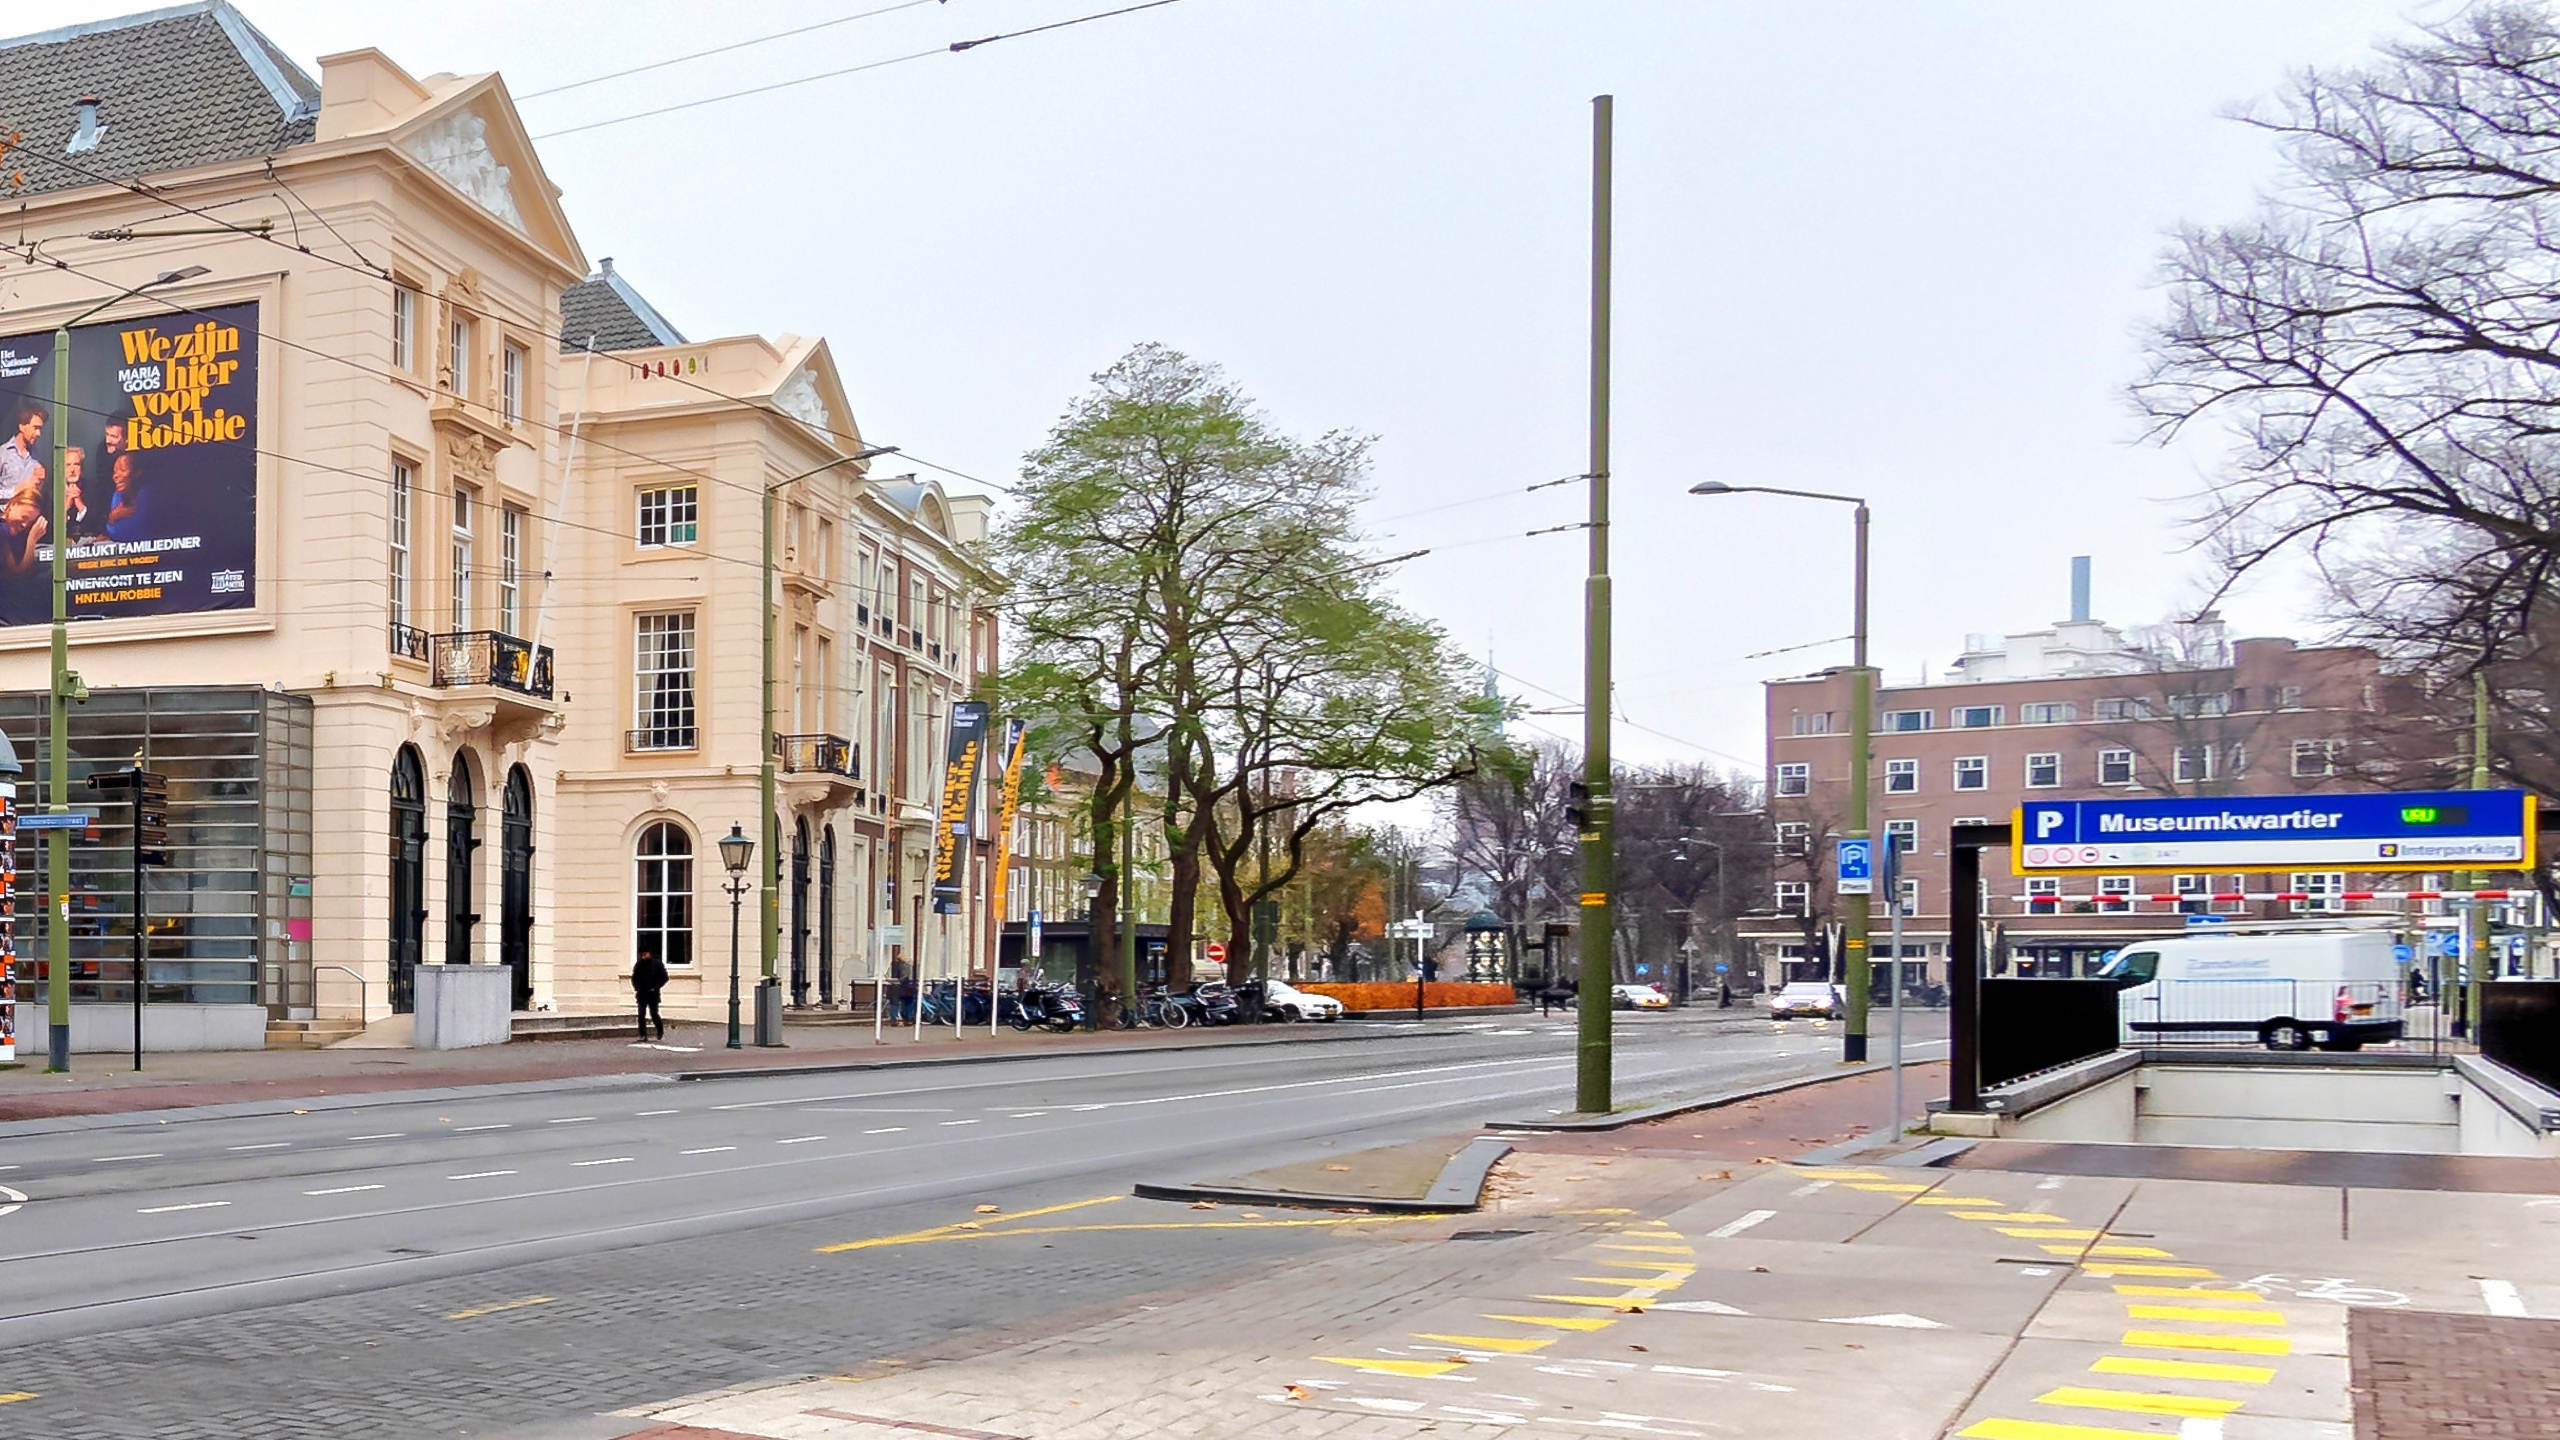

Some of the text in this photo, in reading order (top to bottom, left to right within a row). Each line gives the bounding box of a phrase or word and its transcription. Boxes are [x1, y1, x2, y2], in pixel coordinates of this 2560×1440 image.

[120, 321, 239, 365] We zijn
[118, 366, 161, 382] MARIA
[123, 377, 161, 392] GOOS
[165, 356, 239, 391] hier
[132, 387, 210, 417] voor
[125, 408, 246, 451] Robbie
[66, 543, 118, 559] MISLUKT
[118, 536, 201, 553] FAMILIEDINER
[66, 570, 183, 591] NNENKORT TE ZIEN
[75, 587, 162, 604] HNT.NL/ROBBIE
[2037, 810, 2343, 838] P Museumkwartier
[2401, 842, 2516, 858] Interparking
